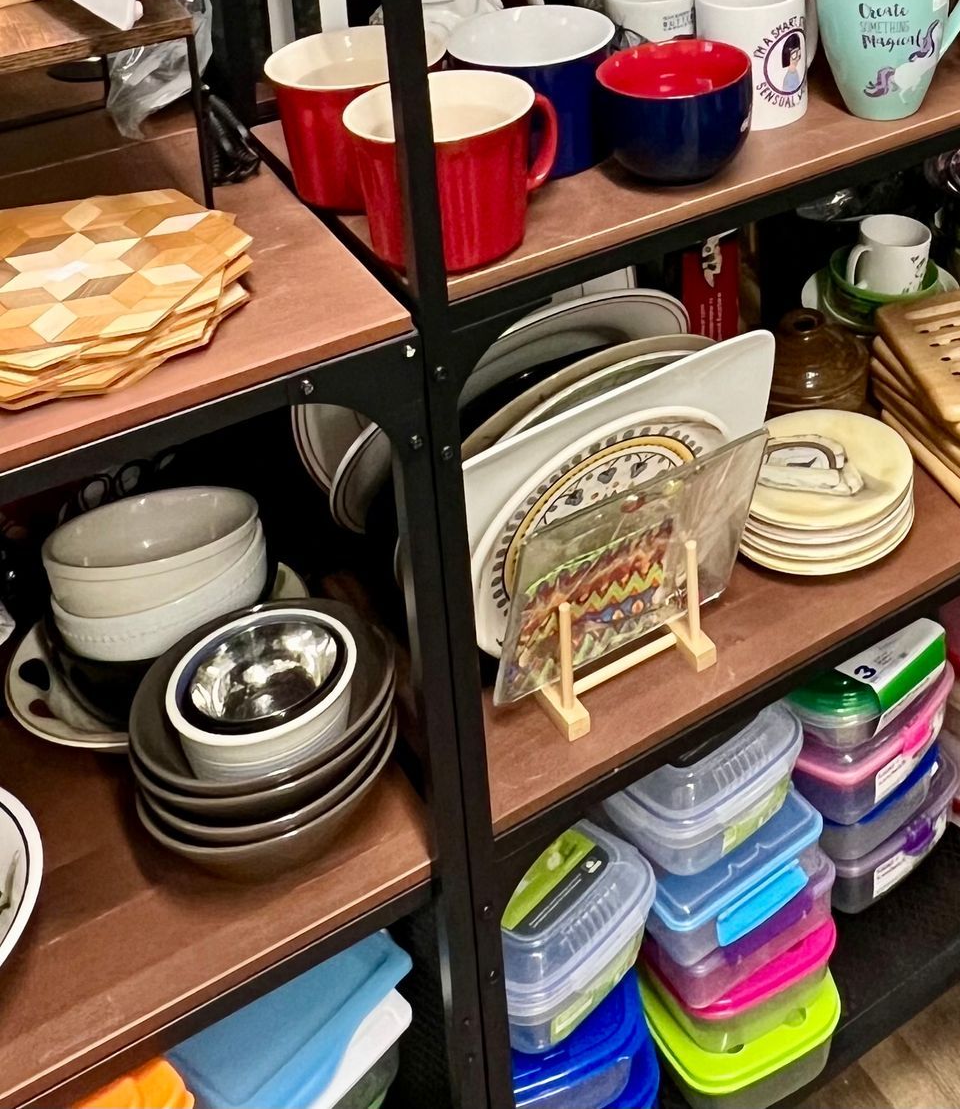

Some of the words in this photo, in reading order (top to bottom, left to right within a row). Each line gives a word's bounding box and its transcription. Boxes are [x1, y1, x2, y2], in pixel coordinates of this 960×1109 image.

[858, 3, 910, 19] Create
[860, 20, 910, 34] SOMETHING
[862, 28, 921, 53] Magical
[756, 81, 796, 109] SENSUAL
[853, 664, 877, 680] 3
